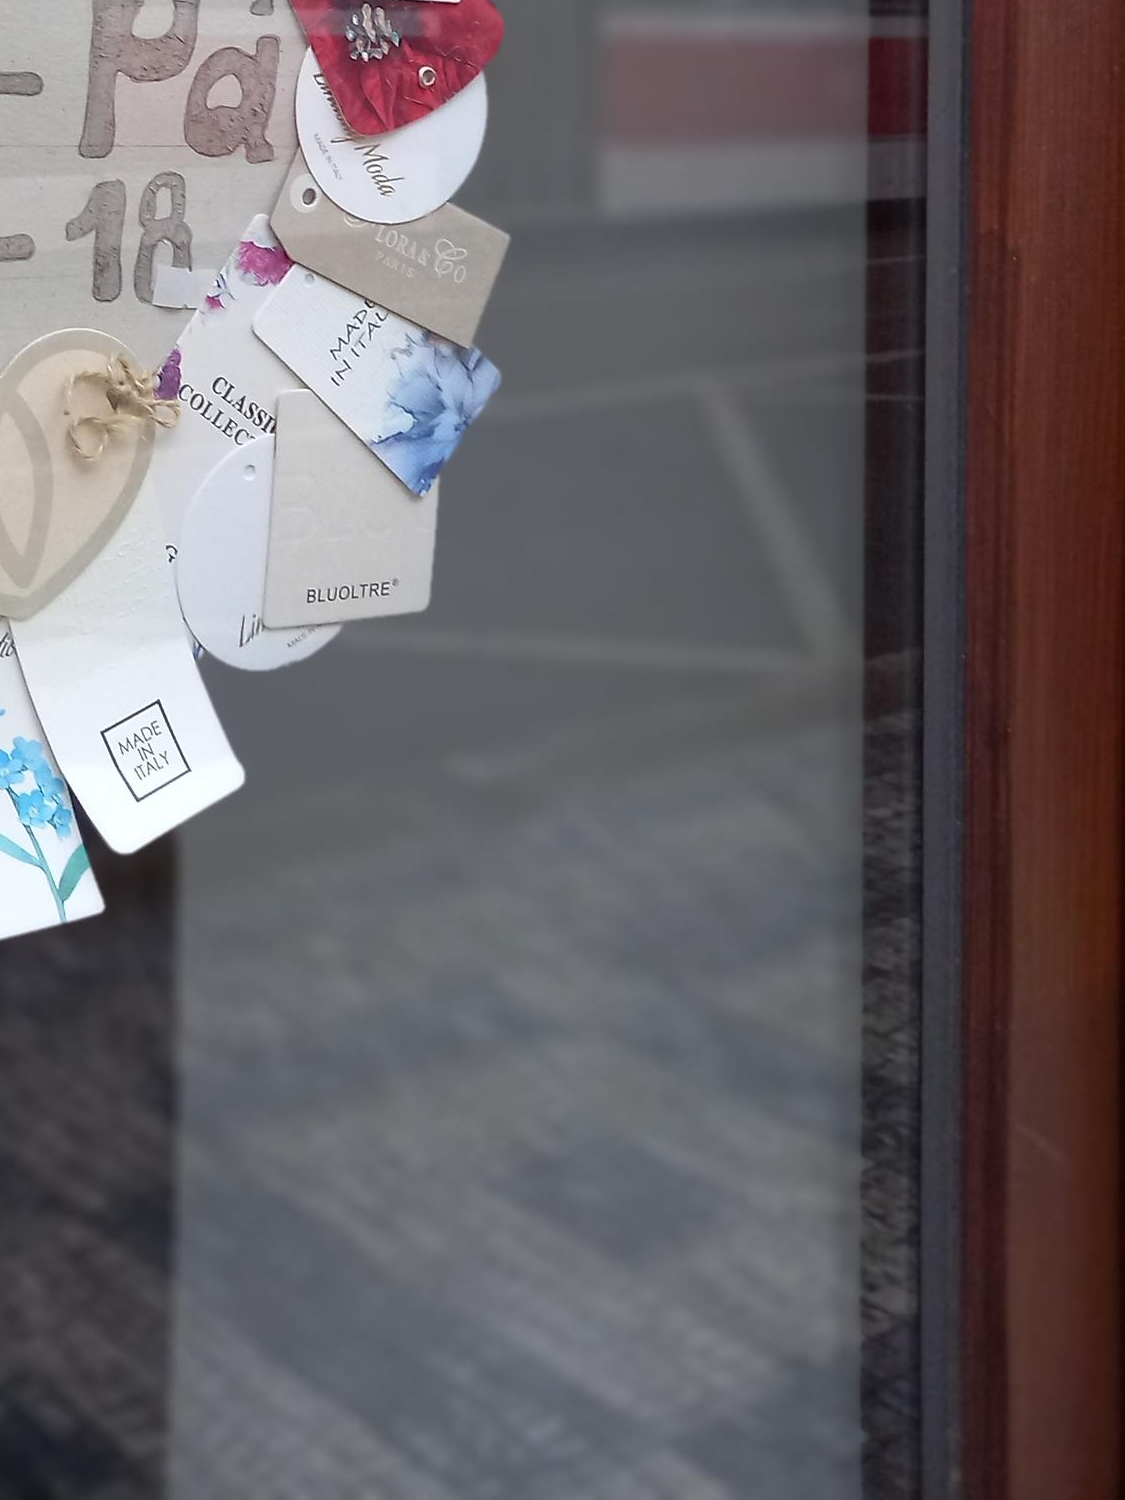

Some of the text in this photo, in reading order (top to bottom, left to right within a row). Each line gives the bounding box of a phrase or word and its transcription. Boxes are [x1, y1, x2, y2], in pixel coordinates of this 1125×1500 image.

[354, 143, 405, 198] Moda
[351, 311, 390, 358] ITAL
[331, 359, 352, 387] IN
[178, 384, 256, 446] COLLEC
[118, 720, 162, 755] MADE
[138, 743, 155, 761] IN
[134, 750, 169, 781] ITALY
